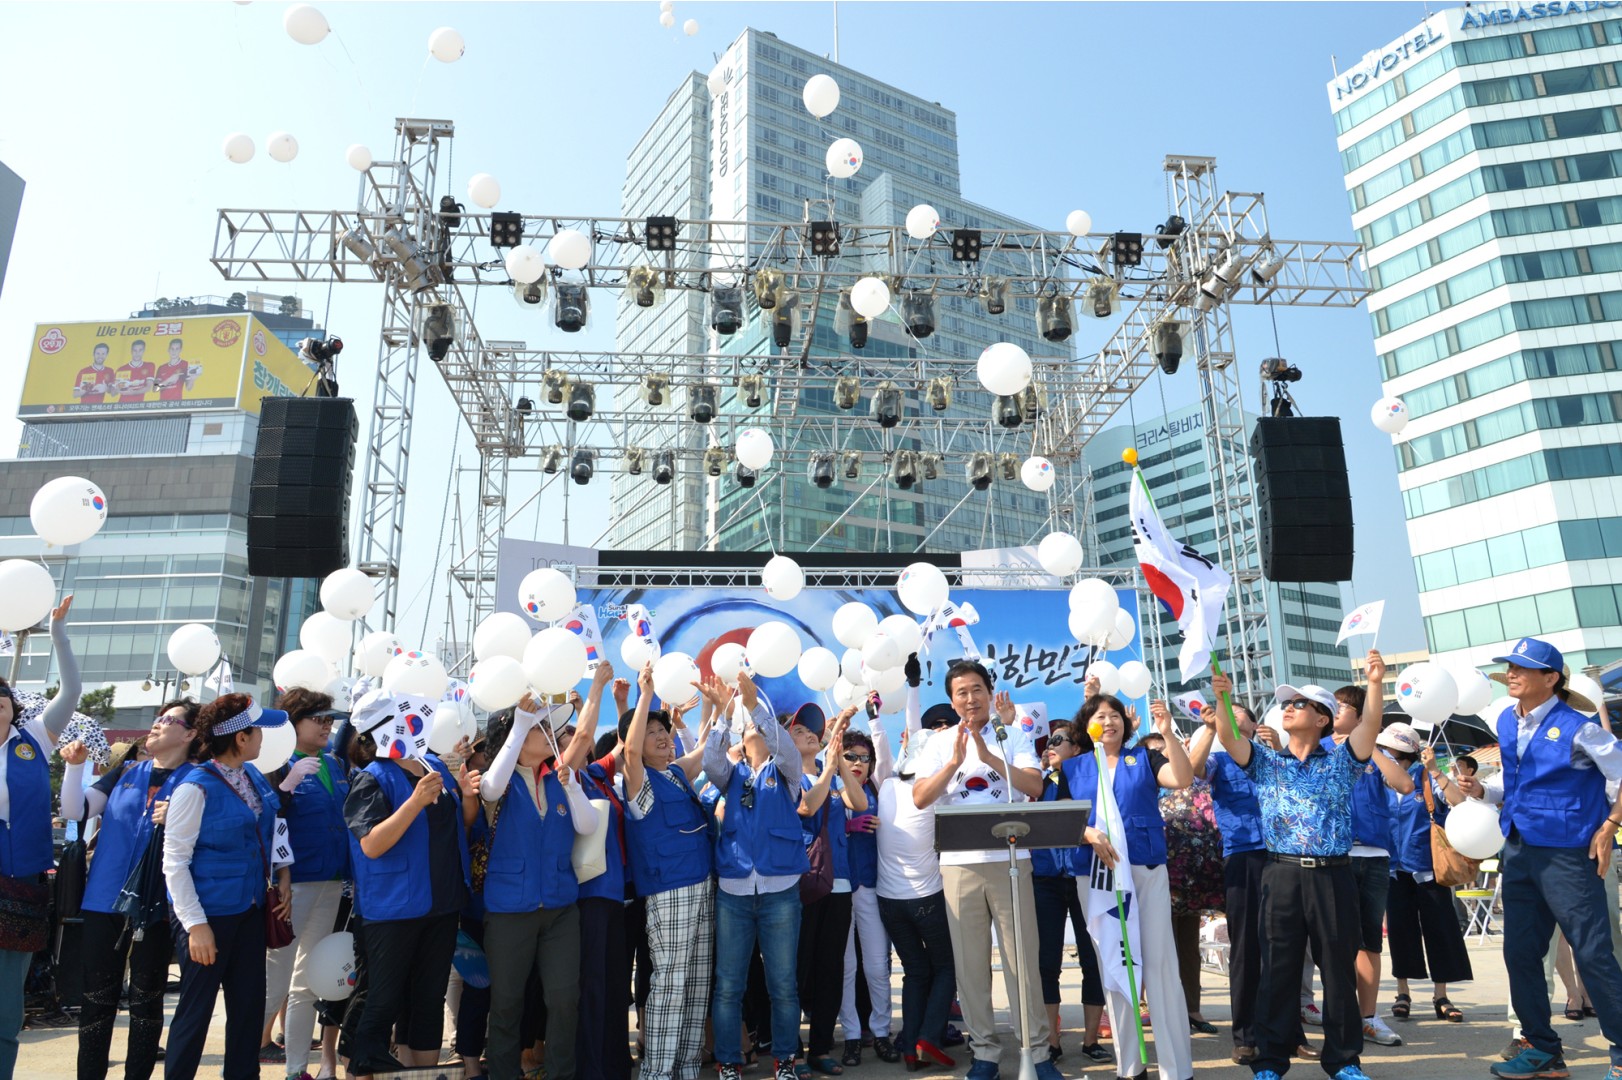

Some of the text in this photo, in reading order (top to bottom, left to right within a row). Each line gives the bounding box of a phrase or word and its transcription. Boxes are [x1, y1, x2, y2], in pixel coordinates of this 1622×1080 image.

[1333, 24, 1444, 101] NOVOTEL
[719, 91, 729, 178] SENCLOUD
[96, 321, 184, 337] We Love 3분
[1136, 411, 1205, 450] 크리스탈비치
